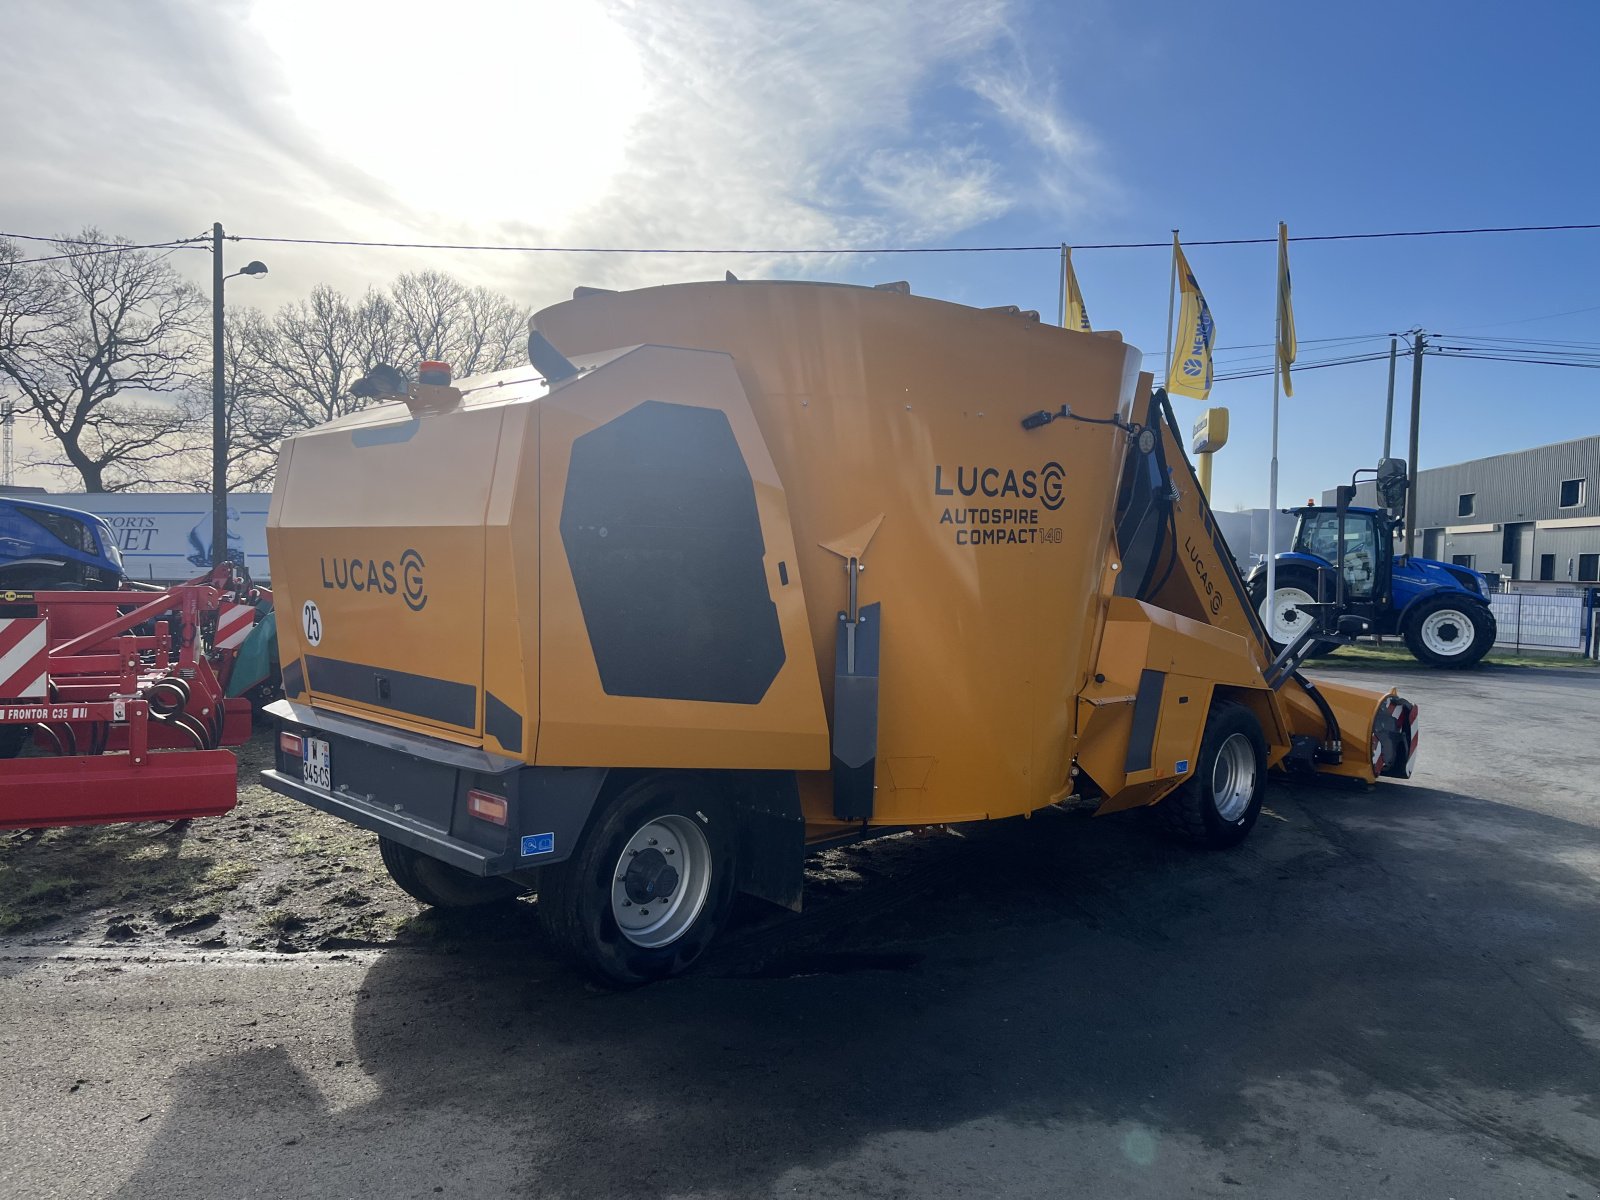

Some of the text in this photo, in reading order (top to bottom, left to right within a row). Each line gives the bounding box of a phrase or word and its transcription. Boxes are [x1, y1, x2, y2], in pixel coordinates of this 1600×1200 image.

[940, 508, 1038, 525] AUTOSPIRE
[956, 528, 1037, 545] COMPACT
[305, 605, 320, 641] 25
[8, 709, 68, 719] FRONTOR C35
